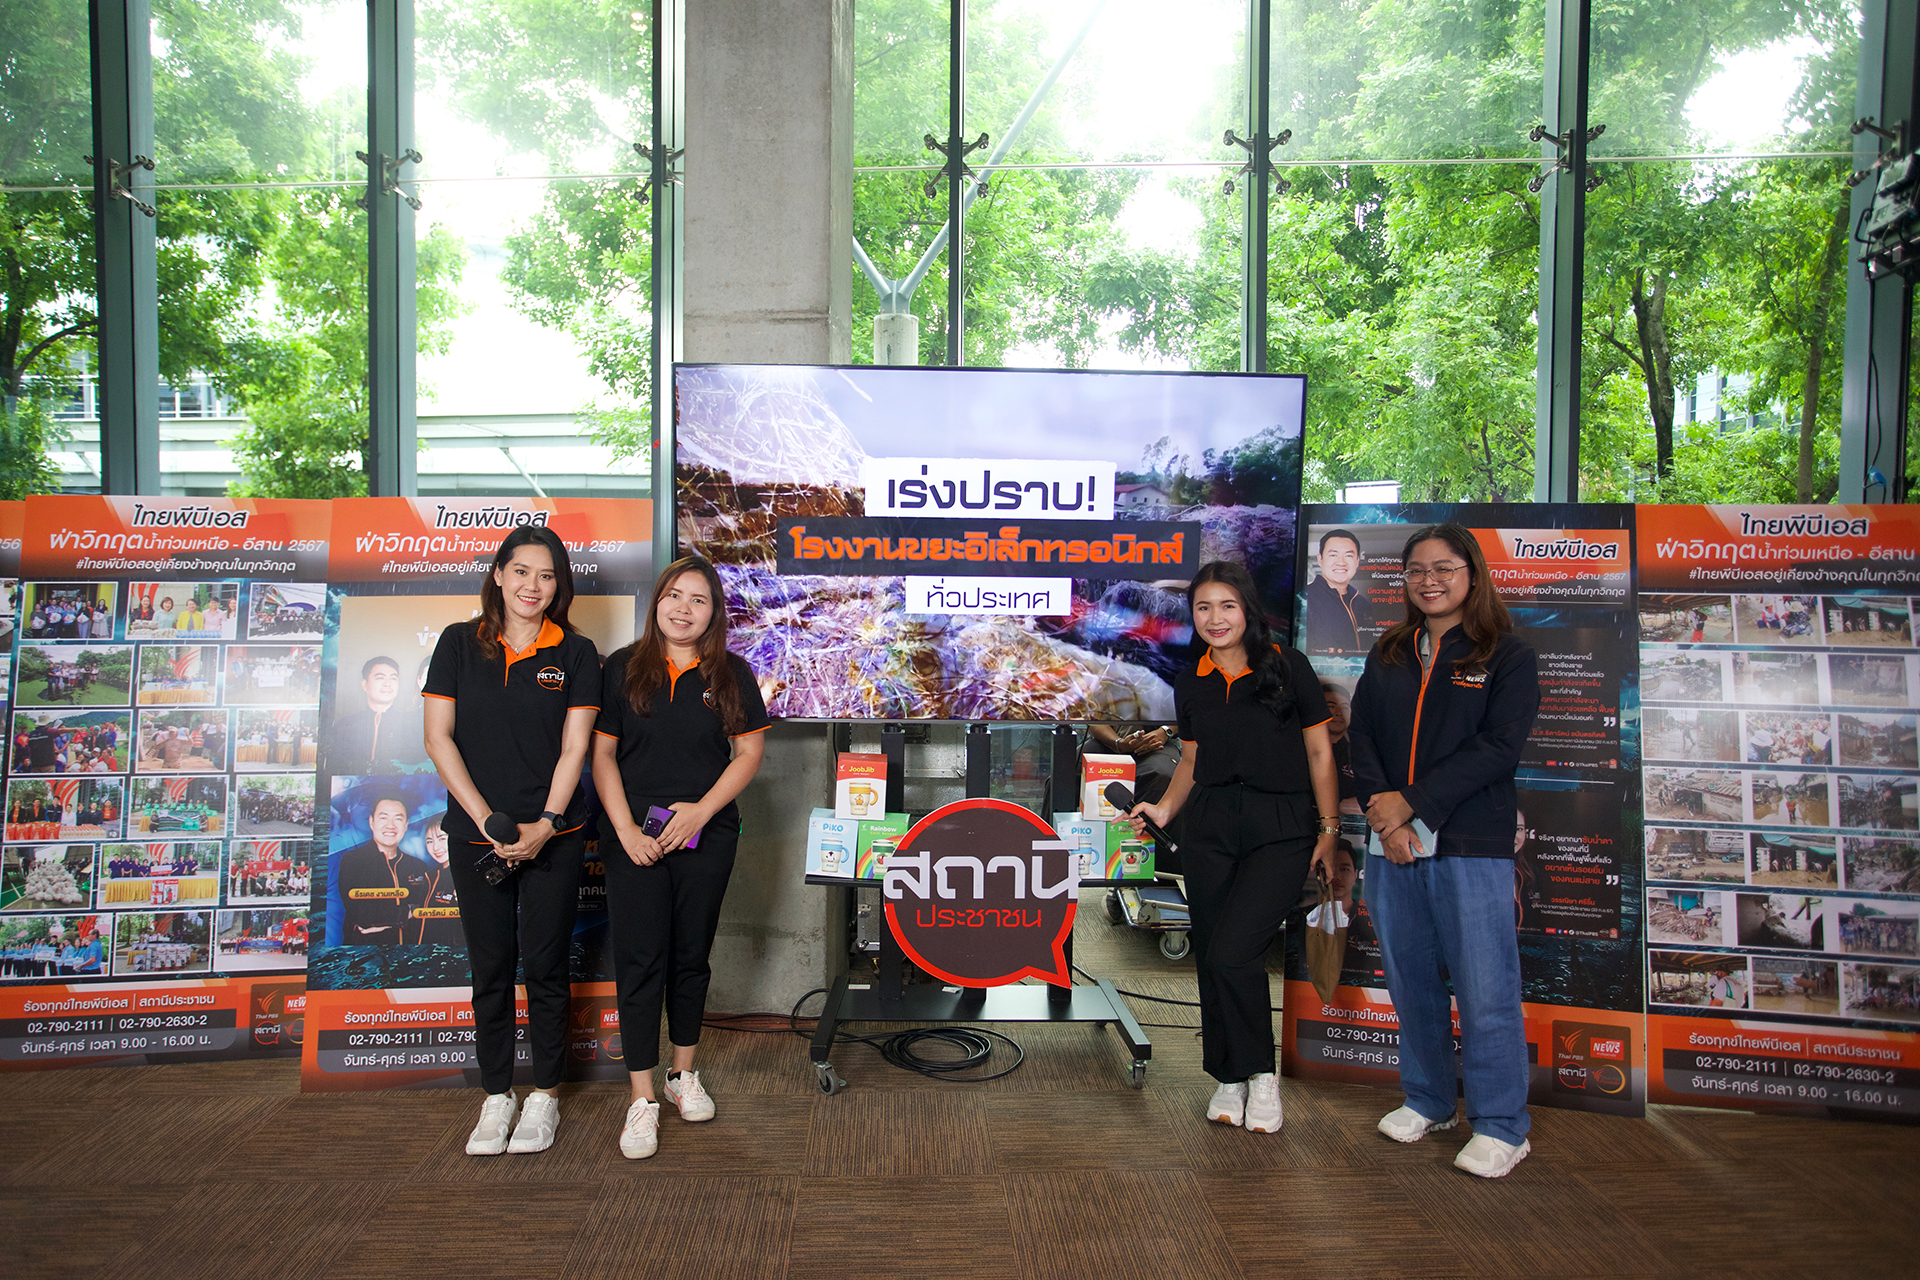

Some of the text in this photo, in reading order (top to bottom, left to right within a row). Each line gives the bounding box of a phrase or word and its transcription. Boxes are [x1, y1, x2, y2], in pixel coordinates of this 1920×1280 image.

[888, 464, 1096, 512] เร่งปราบ!
[132, 503, 250, 528] ไทยพีบีเอส
[435, 504, 550, 529] ไทยพีบีเอส
[1740, 512, 1870, 537] ไทยพีบีเอส
[243, 537, 283, 552] อีสาน
[287, 539, 326, 552] 2567
[589, 540, 626, 553] 2567
[789, 526, 1185, 564] โรงงานขยะอิเล็กทรอนิกส์
[1513, 537, 1619, 560] ไทยพีบีเอส
[1868, 545, 1915, 560] อีสาน
[75, 556, 297, 574] #ไทยพีบีเอสอยู่เคียงข้างคุณในทุกวิกฤต
[1576, 570, 1600, 581] อีสาน
[1603, 572, 1626, 581] 2567
[926, 578, 1050, 610] ทั่วประเทศ
[848, 766, 875, 774] JoobJib
[1098, 767, 1124, 775] JoobJib
[822, 823, 844, 833] PiKO
[869, 825, 898, 833] Rainbow
[1071, 827, 1092, 835] PiKO
[883, 834, 1082, 900] สถานี
[916, 904, 1042, 928] ประชาชน
[23, 993, 215, 1014] ร้องทุกข์ไทยพีบีเอส สถานีประชาชน
[287, 999, 306, 1008] NEW
[27, 1014, 208, 1034] 02-790-2111 02-790-2630-2
[344, 1010, 447, 1029] ร้องทุกข์ไทยพีบีเอส
[254, 1024, 281, 1035] สถานี
[348, 1032, 423, 1046] 02-790-2111
[1326, 1026, 1399, 1045] 02-790-2111
[21, 1038, 85, 1056] จันทร์-ศุกร์
[90, 1038, 116, 1051] เวลา
[120, 1036, 148, 1049] 9.00
[162, 1034, 196, 1047] 16.00
[199, 1034, 212, 1046] น.
[1593, 1042, 1621, 1054] NEWS
[1688, 1032, 1901, 1061] ร้องทุกข์ไทยพีบีเอส สถานีประชาชน
[343, 1052, 406, 1069] จันทร์-ศุกร์
[410, 1051, 436, 1065] เวลา
[440, 1051, 466, 1064] 9.00
[517, 1050, 529, 1060] น.
[1321, 1045, 1384, 1065] จันทร์-ศุกร์
[1558, 1067, 1587, 1078] สถานี
[1695, 1055, 1895, 1084] 02-790-2111 02-790-2630-2
[1691, 1074, 1759, 1095] จันทร์-ศุกร์
[1764, 1083, 1793, 1097] เวลา
[1798, 1085, 1828, 1099] 9.00
[1844, 1089, 1882, 1104] 16.00
